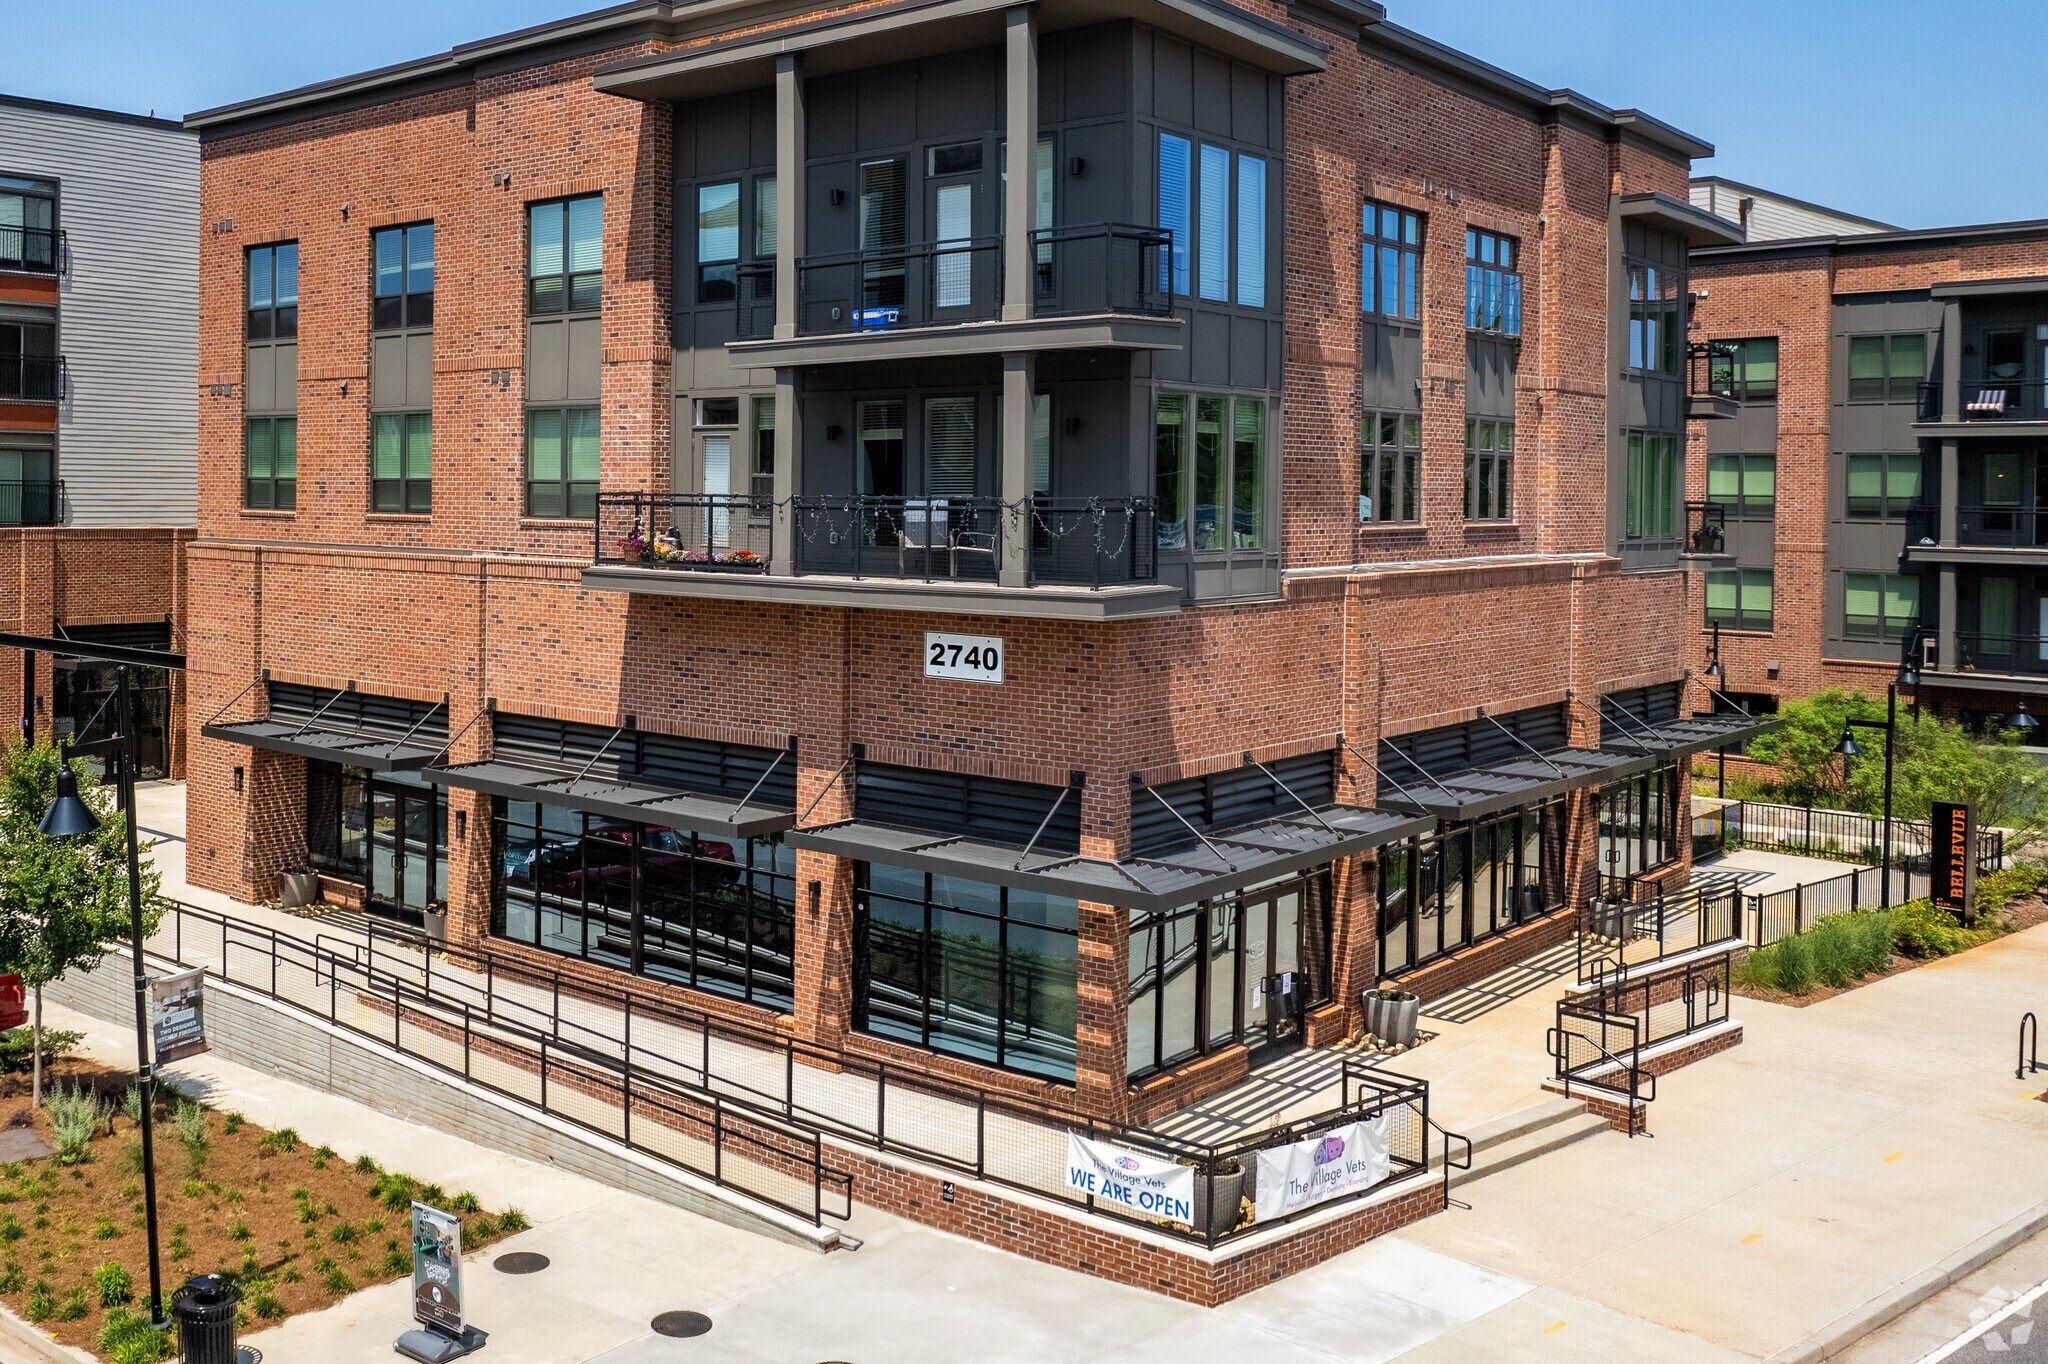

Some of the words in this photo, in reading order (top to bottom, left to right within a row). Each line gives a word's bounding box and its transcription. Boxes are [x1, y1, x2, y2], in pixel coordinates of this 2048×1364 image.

[930, 643, 998, 671] 2740
[1950, 809, 1965, 898] BELLEVUE
[156, 1033, 178, 1044] KITCHEN
[179, 1026, 202, 1037] FINISHES
[173, 1020, 197, 1032] DESIGNER
[1092, 1158, 1107, 1173] The
[1108, 1166, 1141, 1186] Village
[1144, 1176, 1166, 1189] Vets
[1289, 1177, 1308, 1196] The
[1310, 1168, 1342, 1187] Village
[1345, 1159, 1366, 1175] Vets
[1070, 1167, 1095, 1192] WE
[1100, 1179, 1133, 1205] ARE
[1138, 1191, 1189, 1220] OPEN
